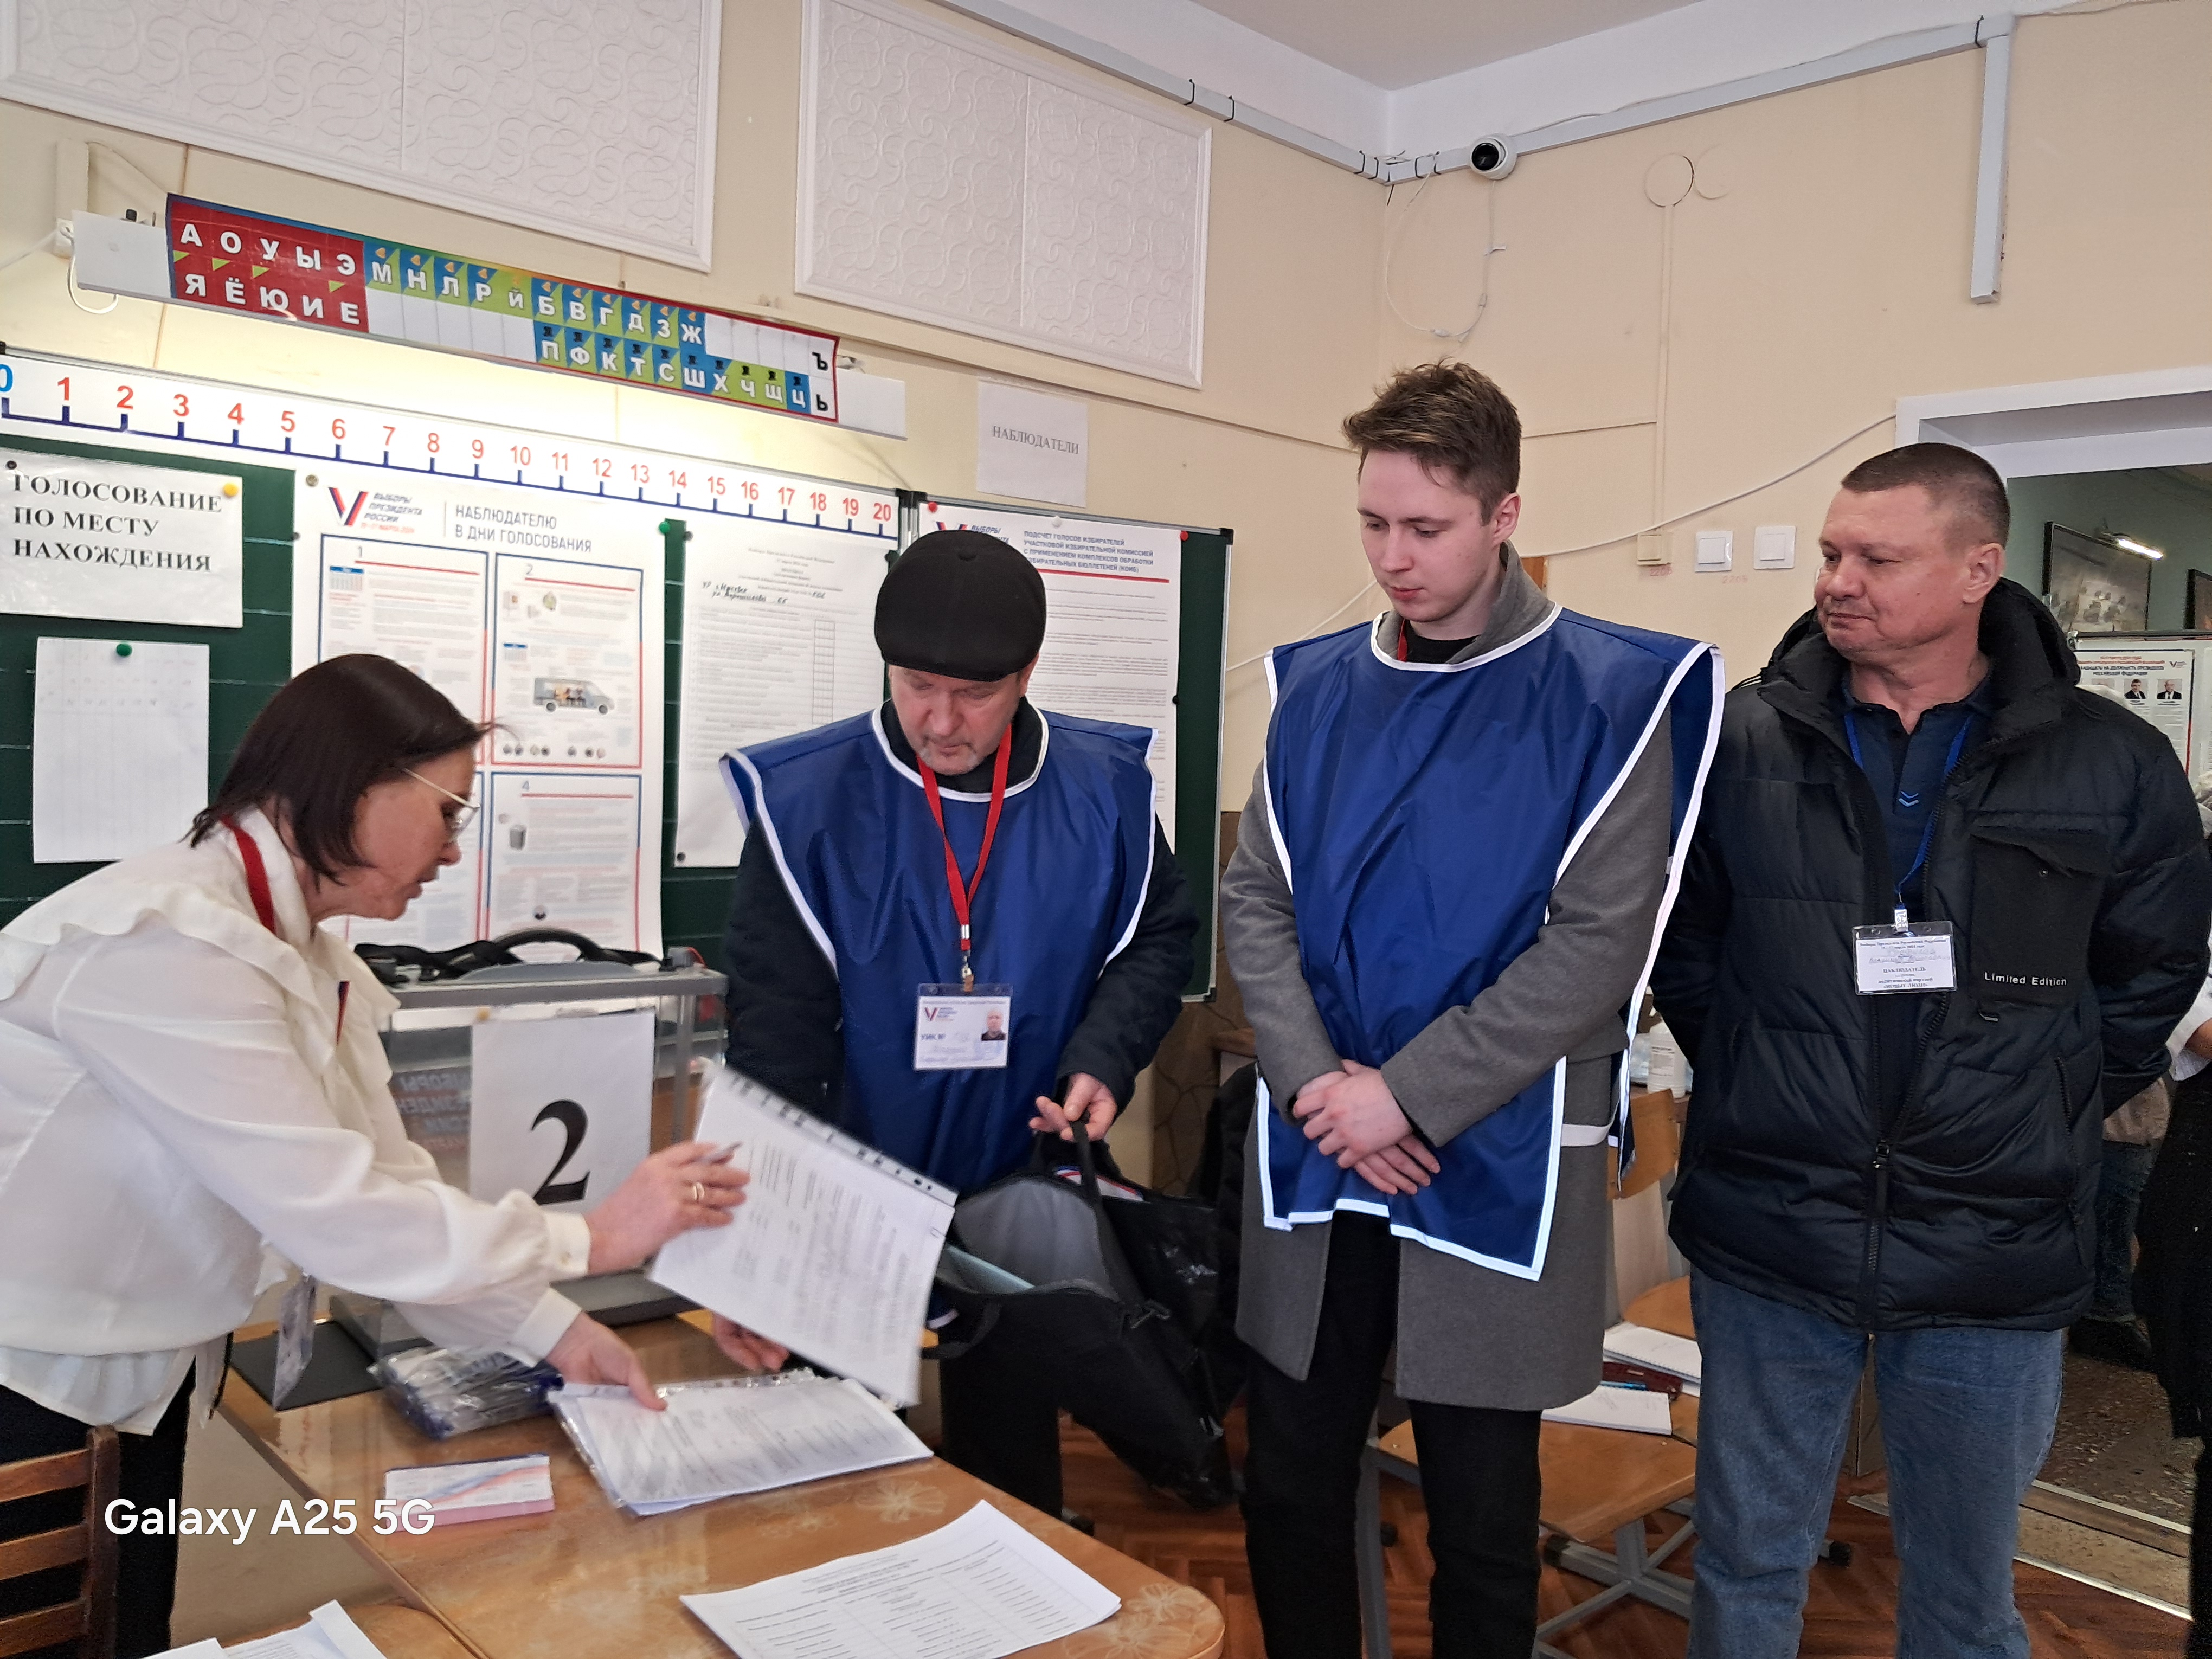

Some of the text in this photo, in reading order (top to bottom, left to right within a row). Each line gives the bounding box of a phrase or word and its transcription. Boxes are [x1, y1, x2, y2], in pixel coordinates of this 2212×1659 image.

[180, 223, 829, 372] А О У Ы Э М Н Л Р Й Б В Г Д З Ж Ъ
[185, 273, 829, 413] Я Ё Ю И Е П Ф К Т С Ш Х Ч Щ Ц Ь
[0, 364, 892, 521] 0 1 2 3 4 5 6 7 8 9 10 11 12 13 14 15 16 17 18 19 20
[992, 425, 1079, 455] НАБЛЮДАТЕЛИ
[12, 474, 222, 513] ГОЛОСОВАНИЕ
[14, 506, 160, 537] ПО МЕСТУ
[455, 504, 557, 530] НАБЛЮДАТЕЛЮ
[357, 545, 363, 558] 1
[455, 524, 592, 552] В ДНИ ГОЛОСОВАНИЯ
[1024, 531, 1125, 546] ПОДСЧЕТ ГОЛОСОВ ИЗБИРАТЕЛЕЙ
[1024, 540, 1154, 557] УЧАСТКОВОЙ ИЗБИРАТЕЛЬНОЙ КОМИССИЕЙ
[14, 539, 211, 571] НАХОЖДЕНИЯ
[525, 563, 534, 575] 2
[1027, 557, 1139, 574] ЗБИРАТЕЛЬНЫХ БЮЛЛЕТЕНЕЙ (КОИБ)
[1030, 549, 1076, 559] ПРИМЕНЕНИЕМ
[1077, 553, 1118, 562] КОМПЛЕКСОВ
[1119, 557, 1154, 565] ОБРАБОТКИ
[1984, 971, 2067, 986] Limited Edition
[530, 1099, 590, 1206] 2
